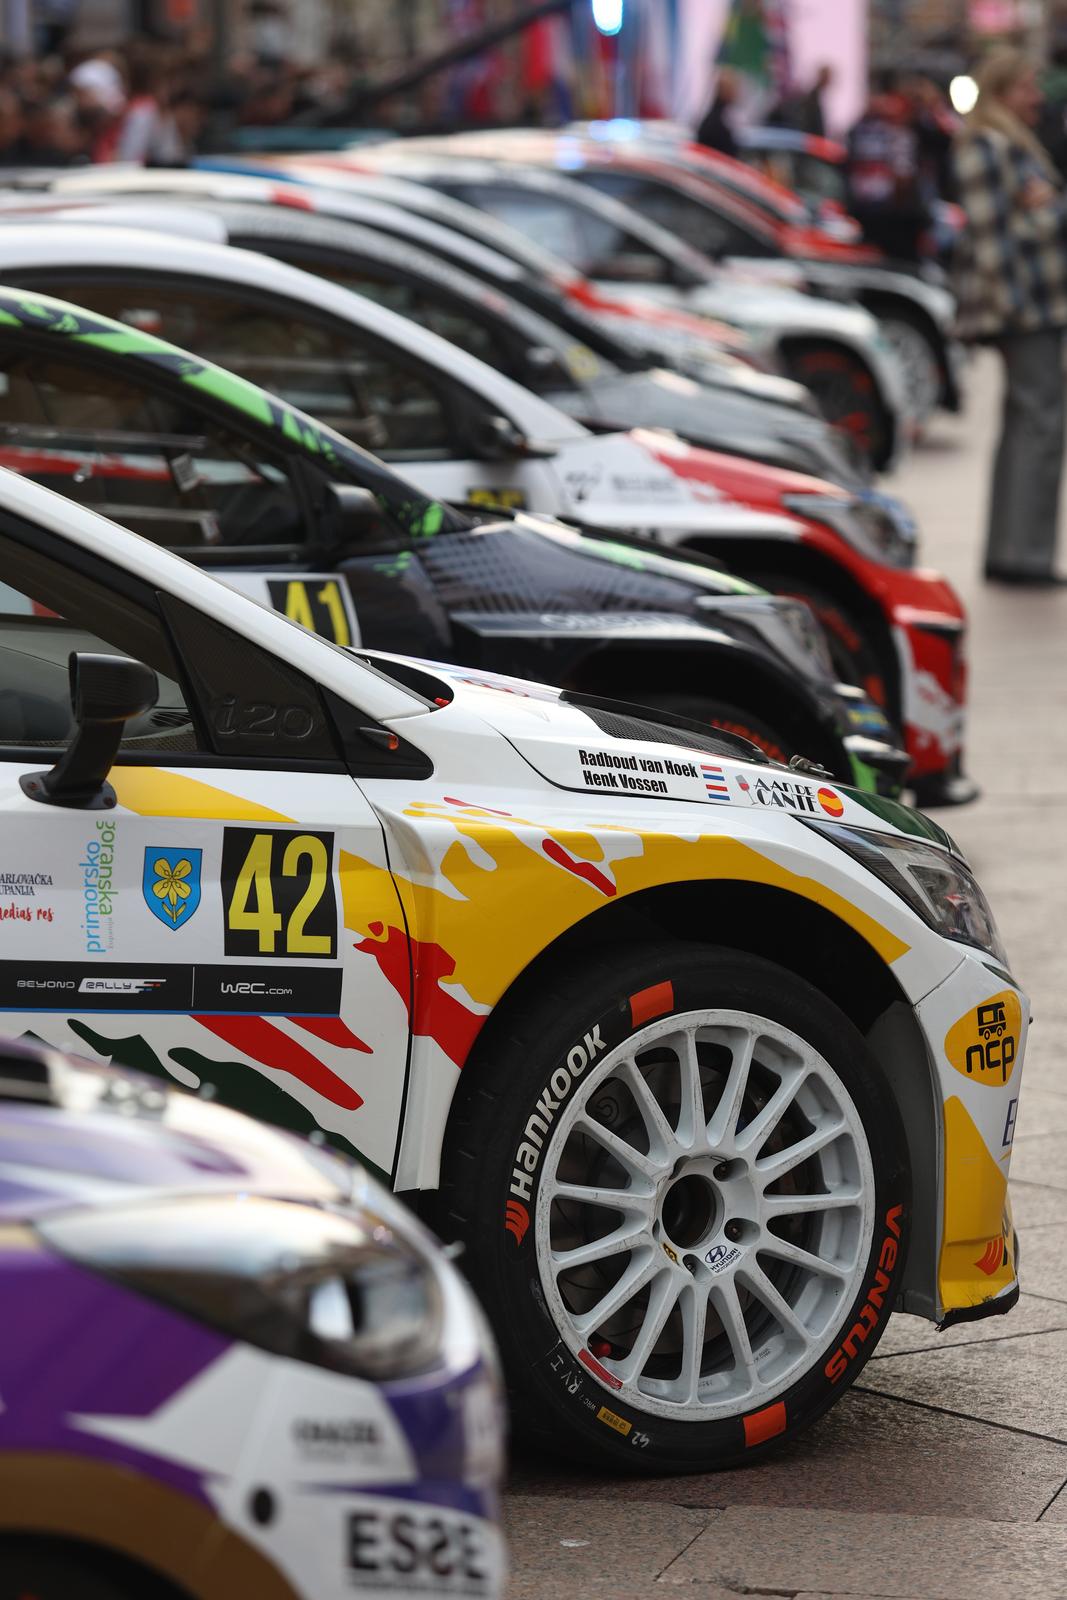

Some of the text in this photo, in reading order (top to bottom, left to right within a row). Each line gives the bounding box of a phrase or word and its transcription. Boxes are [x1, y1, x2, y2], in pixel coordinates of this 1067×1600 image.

[217, 698, 314, 738] i20
[578, 750, 699, 778] Radboud van Hoek
[582, 770, 669, 793] Henk Vossen
[0, 873, 53, 885] ARLOVAČKA
[96, 820, 119, 916] goranska
[78, 841, 106, 952] primorsko
[228, 833, 332, 954] 42
[0, 902, 54, 922] edias res
[17, 980, 132, 990] BEYOND RALLY
[966, 1036, 1014, 1082] ncp
